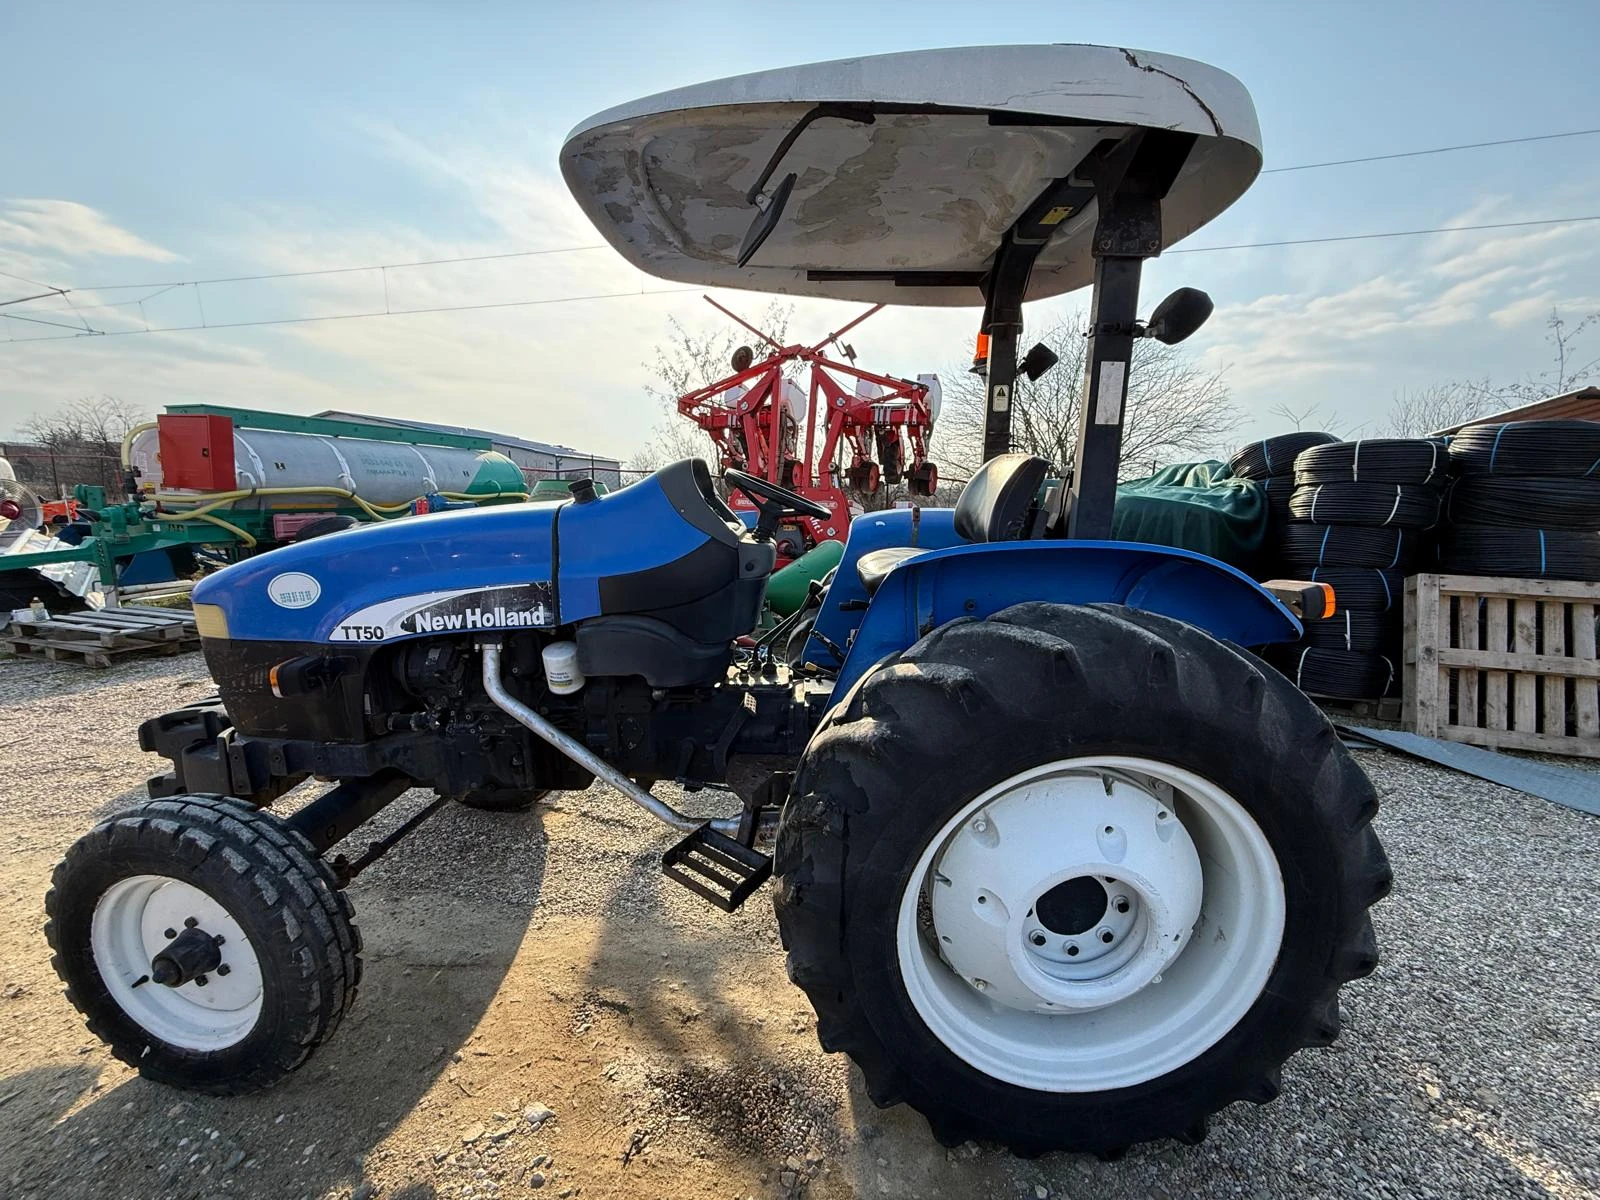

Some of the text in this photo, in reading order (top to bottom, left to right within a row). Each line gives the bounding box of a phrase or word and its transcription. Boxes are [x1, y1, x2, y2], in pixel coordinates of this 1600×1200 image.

[414, 605, 545, 633] New Holland
[340, 625, 385, 641] TT50
